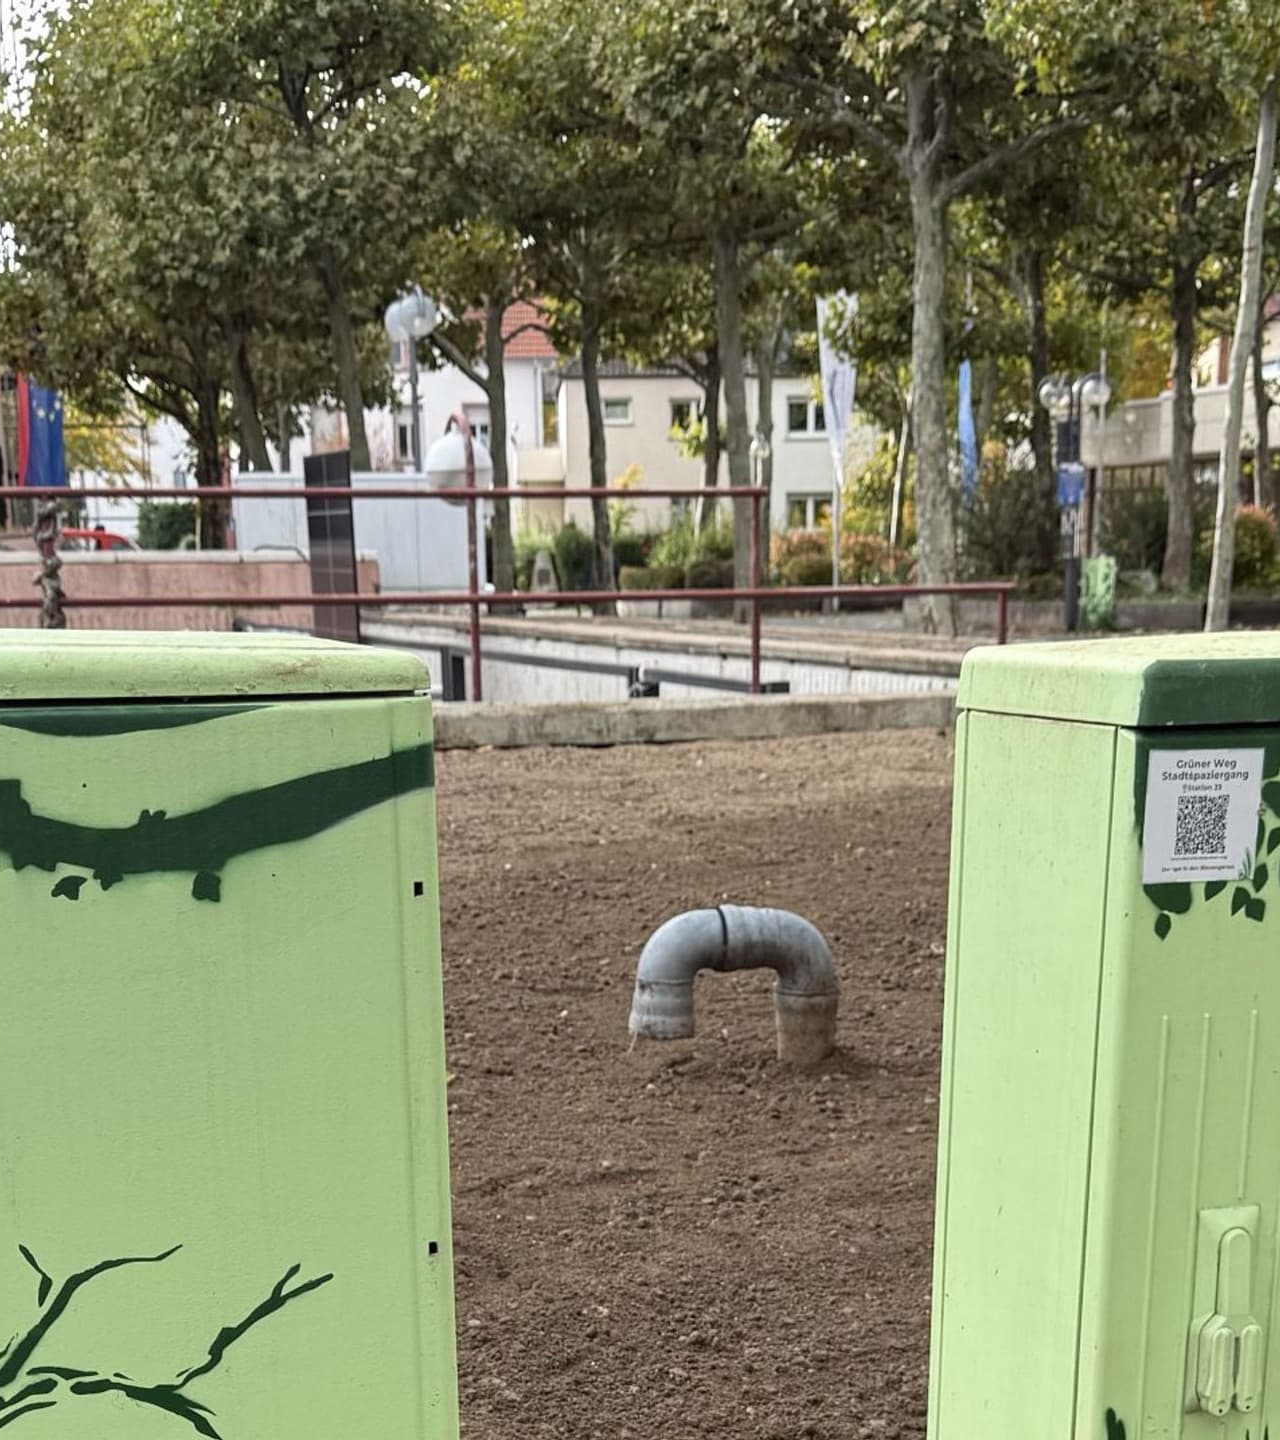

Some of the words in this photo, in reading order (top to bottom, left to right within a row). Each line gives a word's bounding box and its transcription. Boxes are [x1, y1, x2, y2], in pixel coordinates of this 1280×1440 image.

[1176, 759, 1211, 769] Grüner
[1213, 759, 1237, 770] Weg
[1162, 770, 1249, 783] Stadtspaziergang
